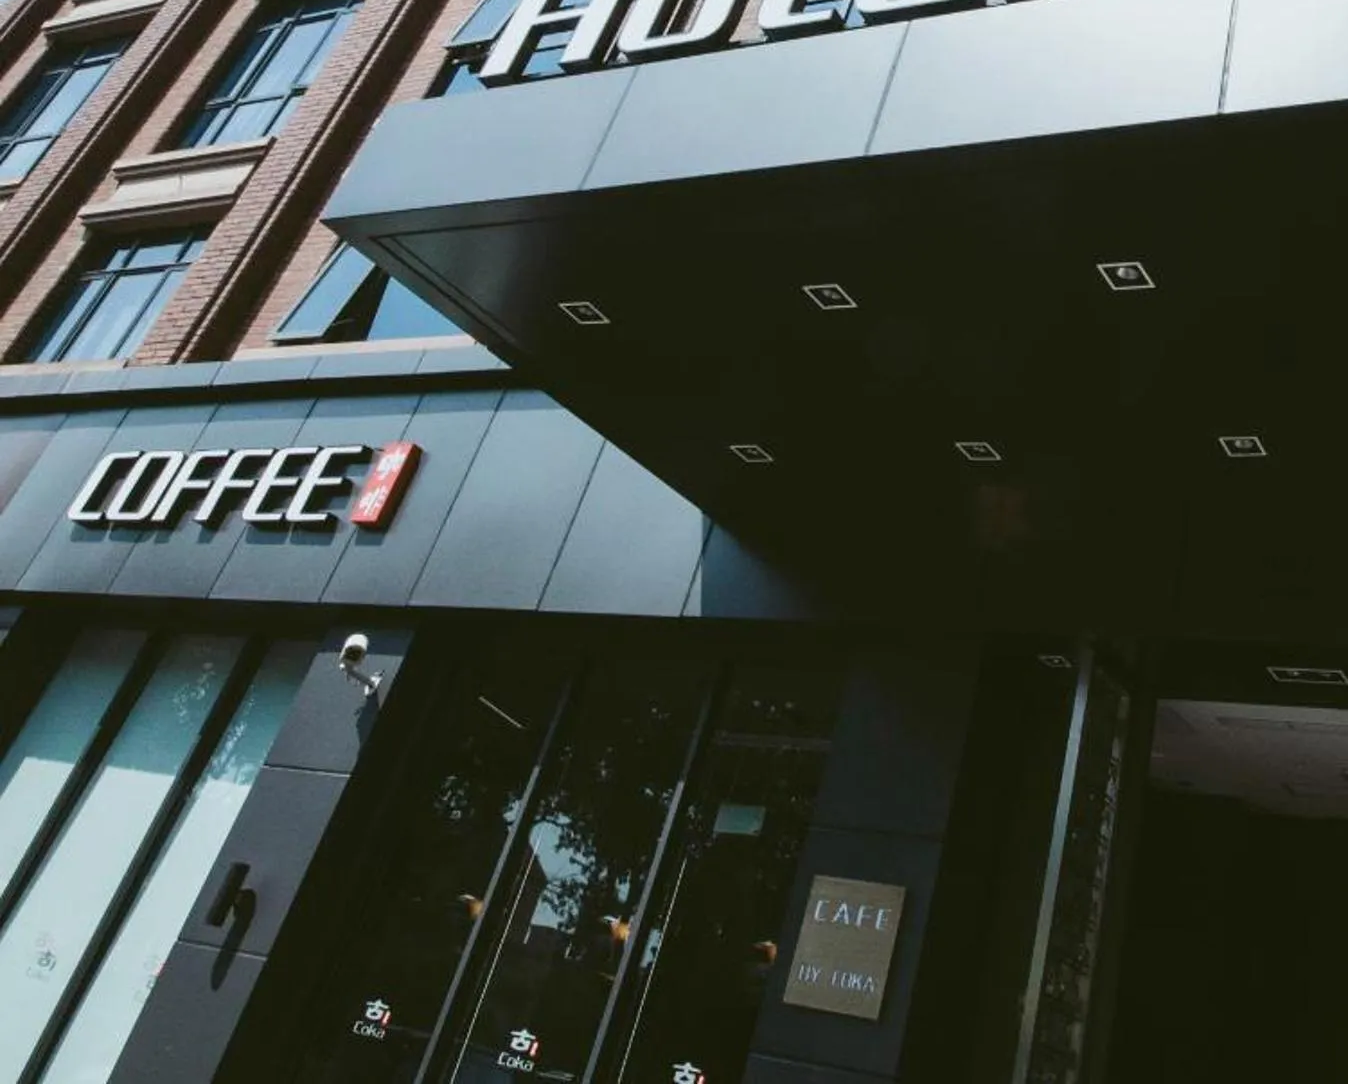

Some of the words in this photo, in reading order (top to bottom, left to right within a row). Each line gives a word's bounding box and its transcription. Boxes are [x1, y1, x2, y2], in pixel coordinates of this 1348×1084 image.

[67, 445, 364, 522] COFFEE
[813, 899, 893, 931] CAFE
[352, 1020, 386, 1040] Coka
[497, 1051, 535, 1071] Coka
